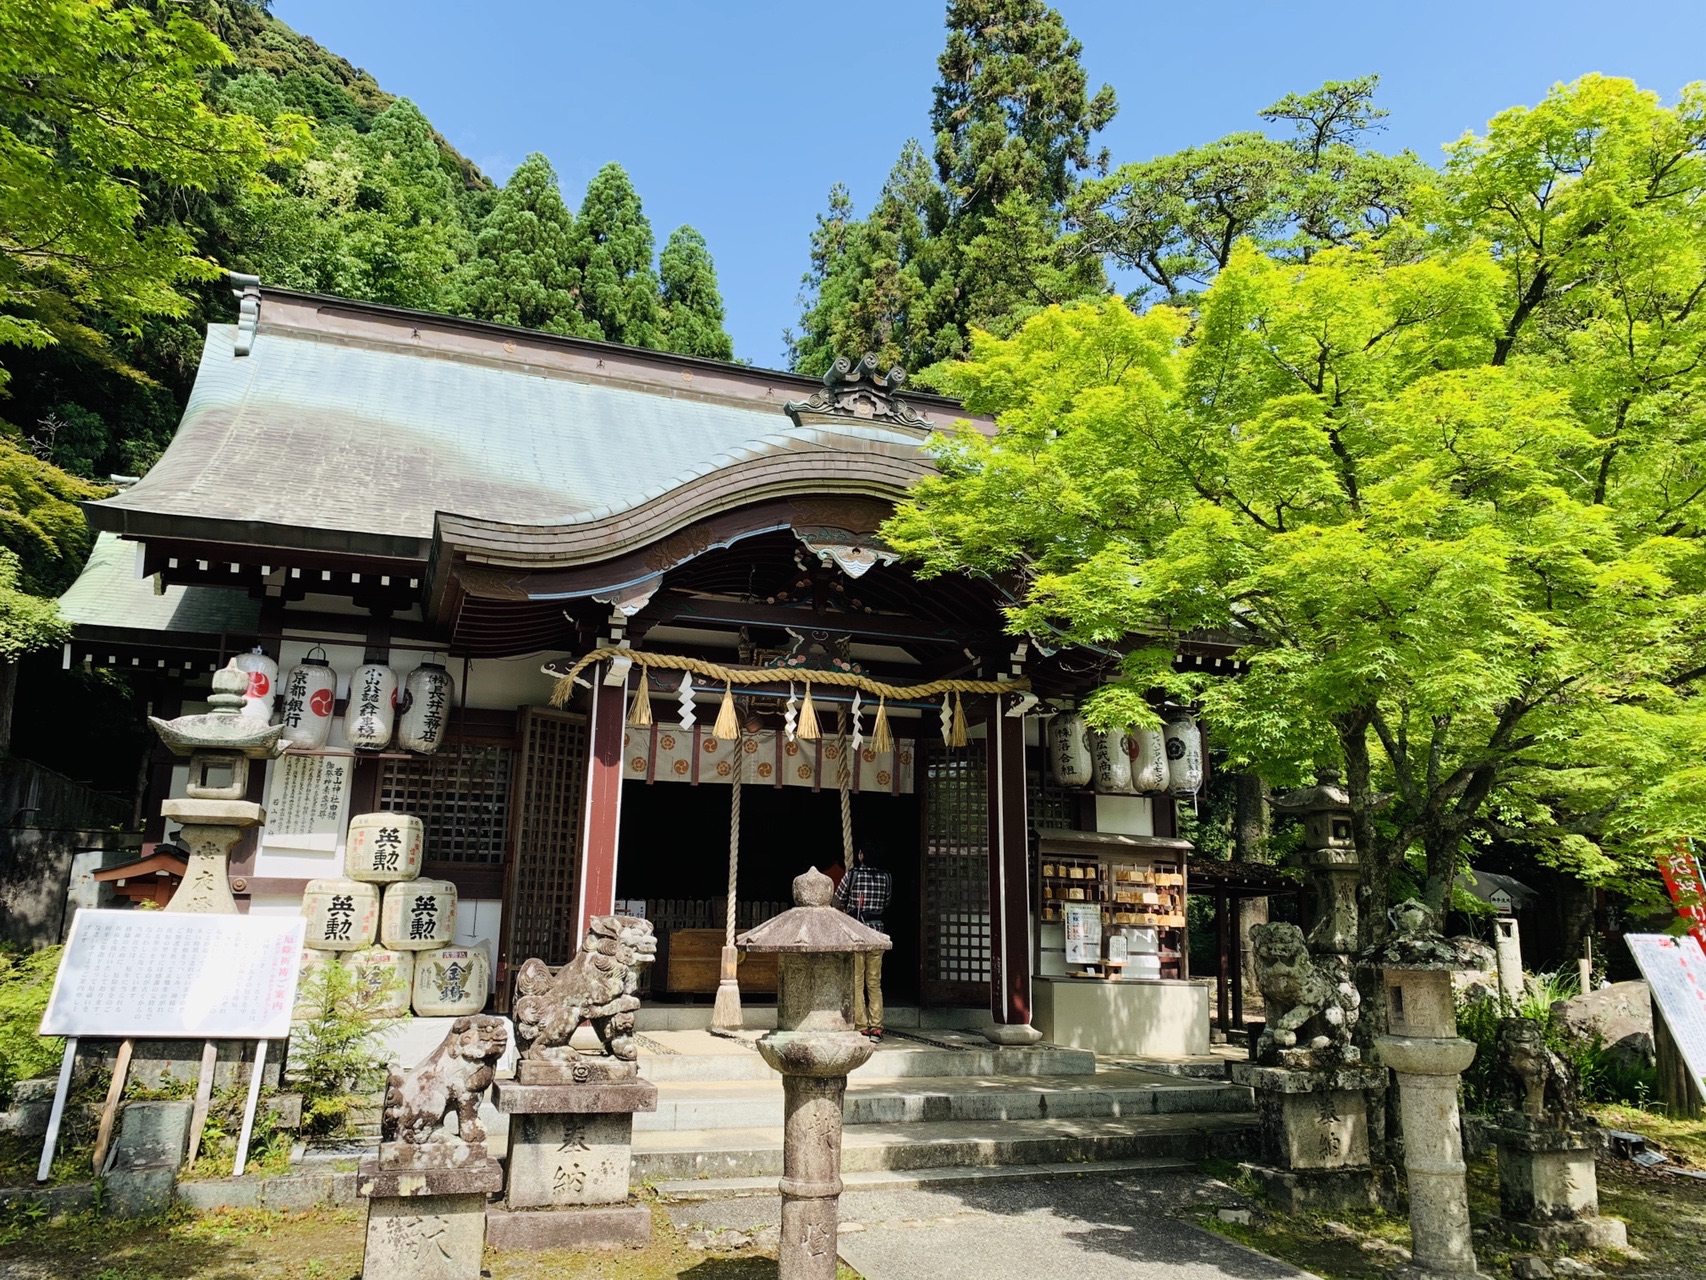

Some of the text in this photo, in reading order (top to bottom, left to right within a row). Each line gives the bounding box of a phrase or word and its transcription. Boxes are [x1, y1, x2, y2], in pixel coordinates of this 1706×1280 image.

[284, 670, 309, 729] 京都銀行
[327, 767, 344, 821] 若山神社由緒
[373, 827, 402, 872] 英勲
[324, 894, 355, 941] 英勲
[410, 895, 438, 940] 英勲
[553, 1120, 591, 1195] 奉納
